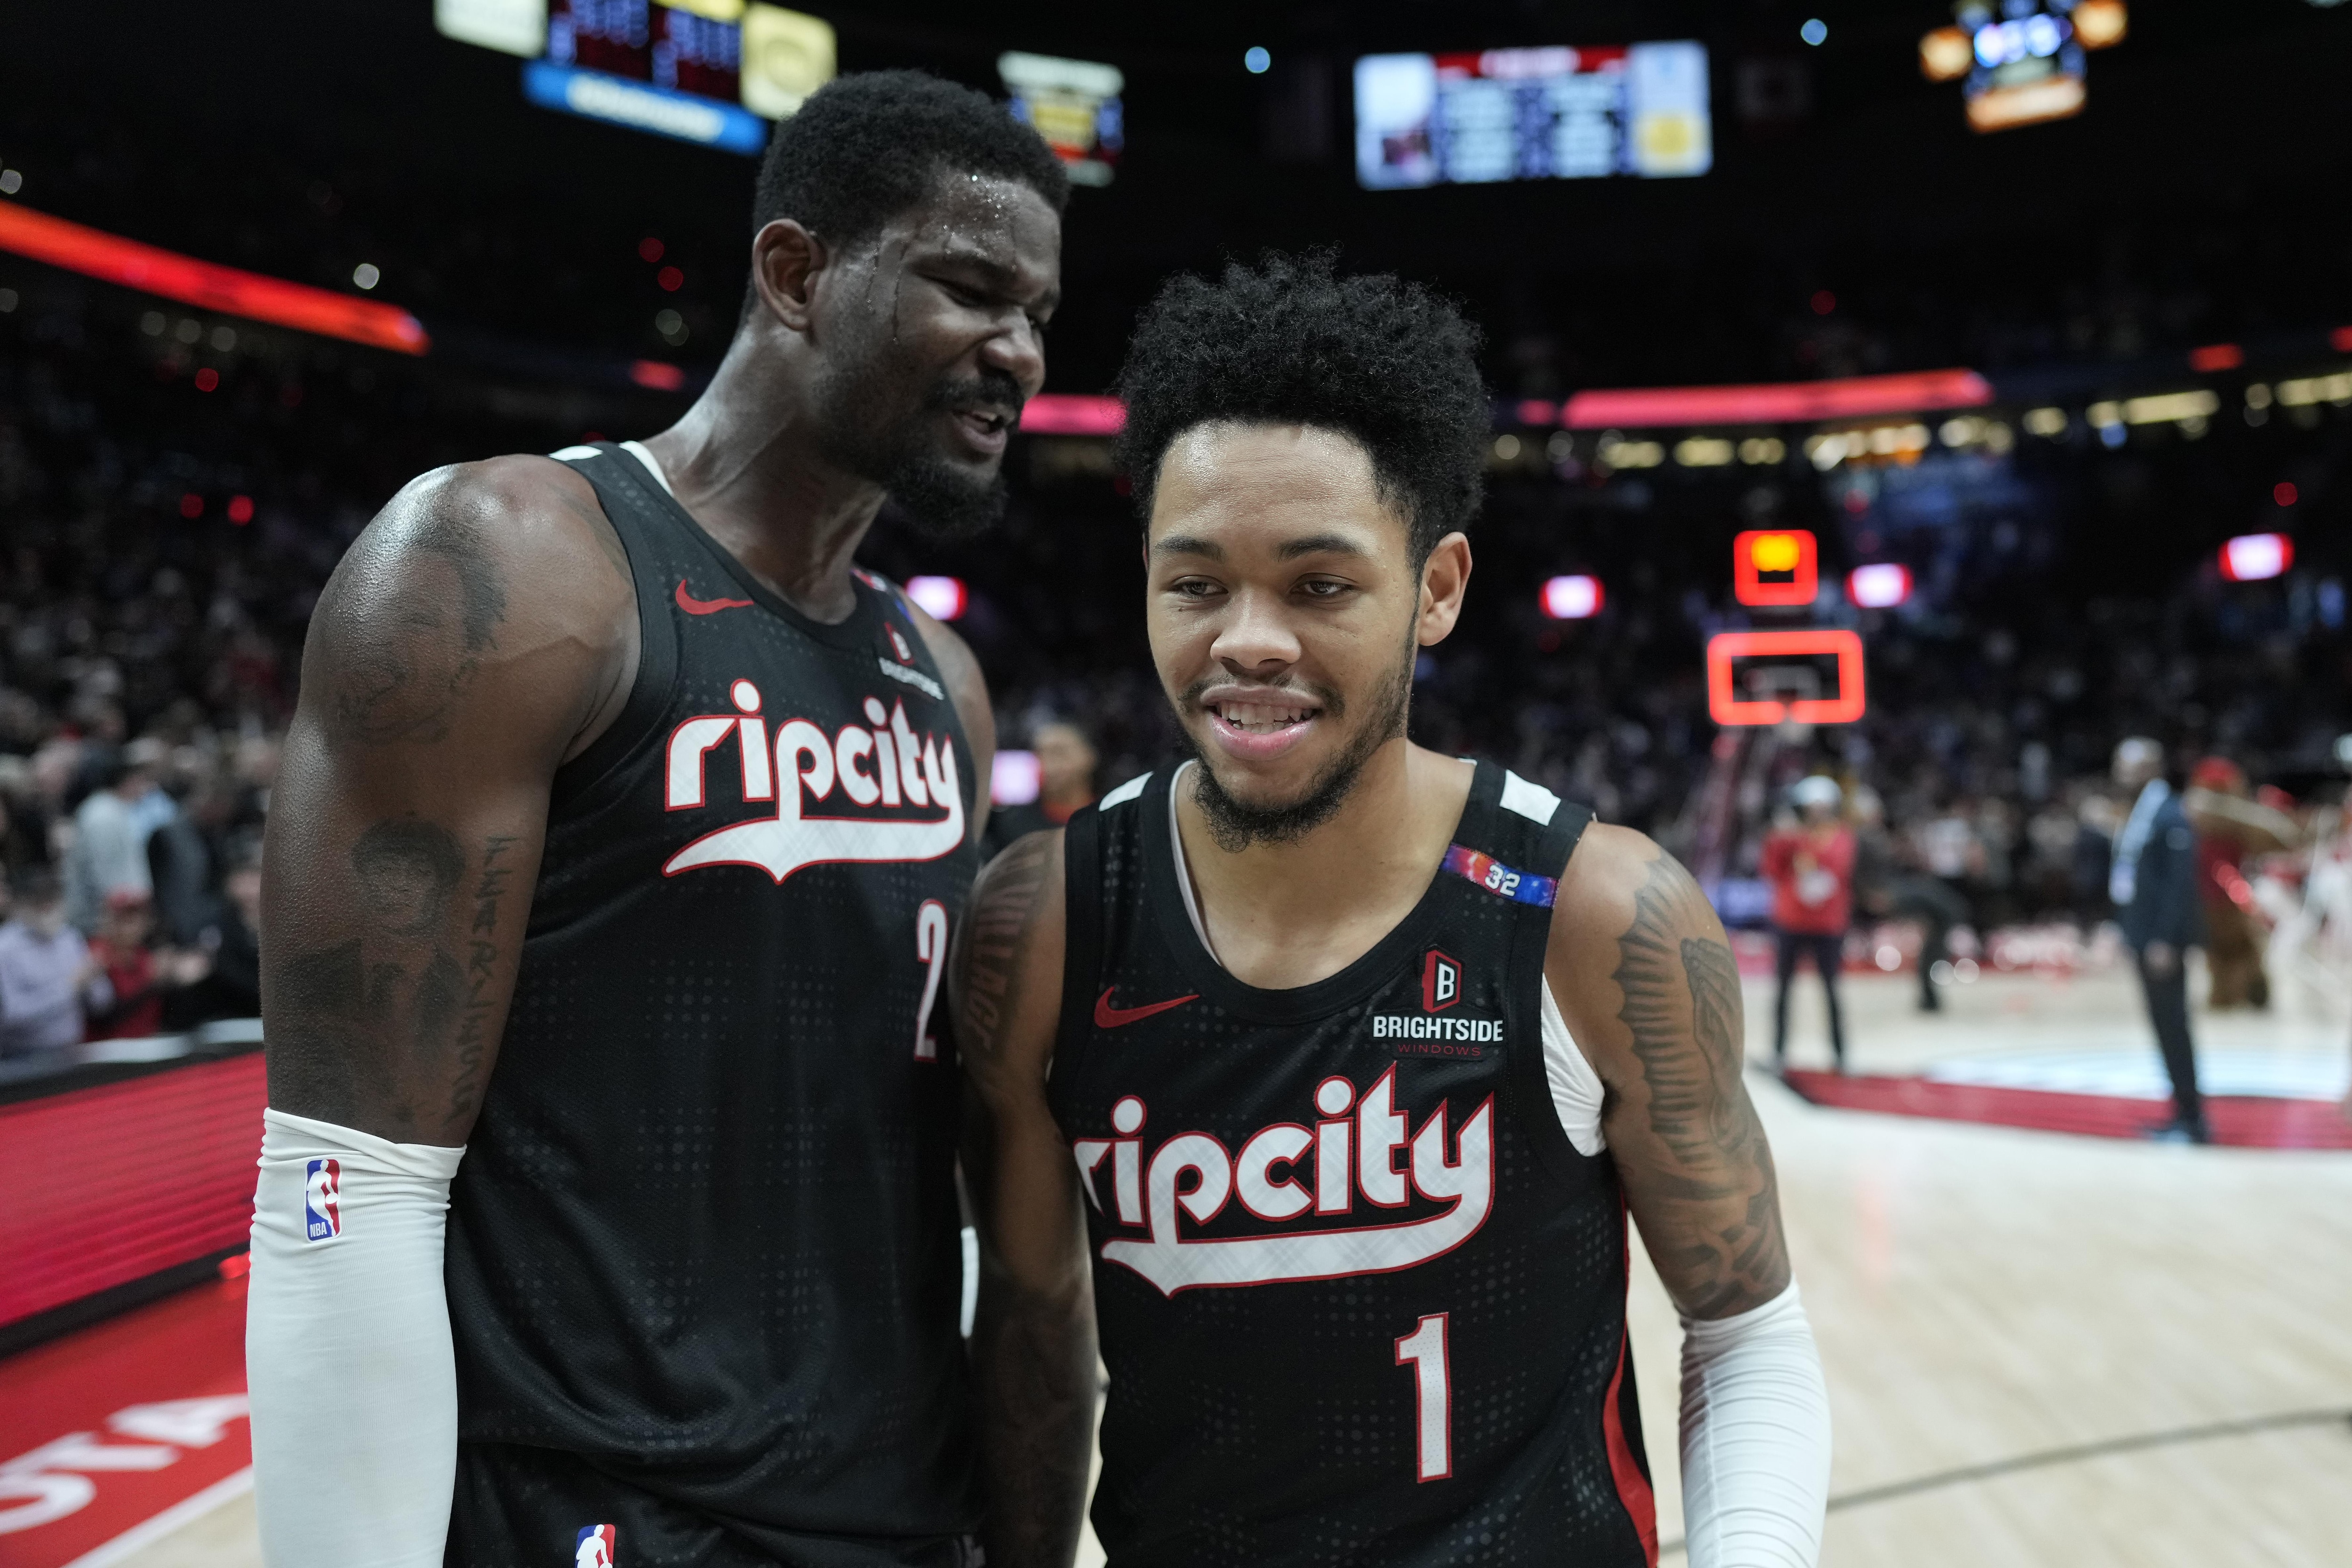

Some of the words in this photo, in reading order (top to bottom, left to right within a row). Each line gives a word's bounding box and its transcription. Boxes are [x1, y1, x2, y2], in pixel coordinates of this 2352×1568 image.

[662, 678, 965, 885] ripcity
[1485, 864, 1520, 896] 32
[914, 898, 948, 1063] 2
[1437, 963, 1455, 1001] B
[1373, 1016, 1503, 1041] BRIGHTSIDE
[1398, 1044, 1481, 1056] WINDOWS
[1073, 1061, 1495, 1299] ripcity
[310, 1221, 327, 1238] NBA
[1394, 1312, 1453, 1484] 1
